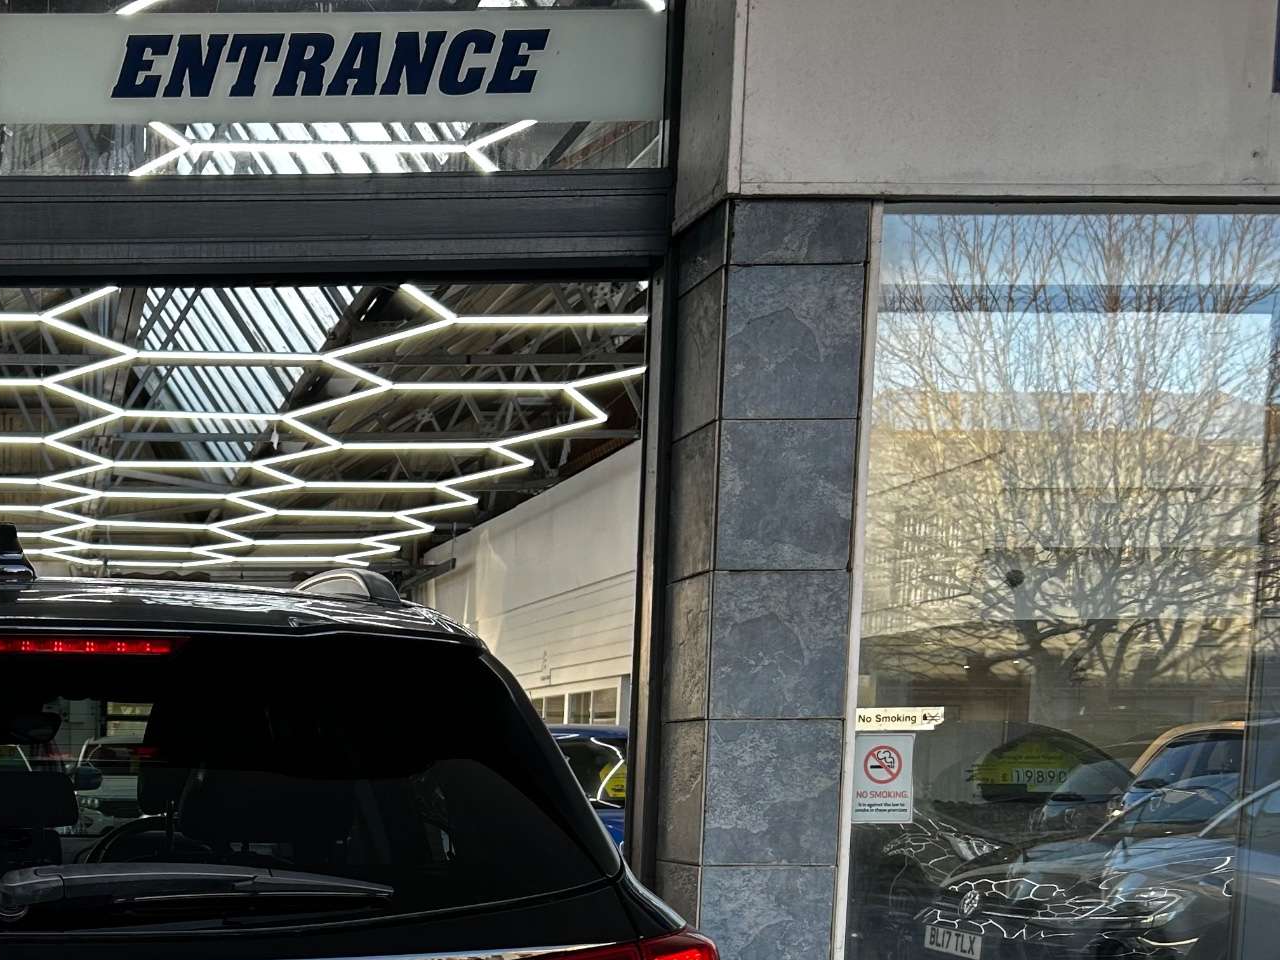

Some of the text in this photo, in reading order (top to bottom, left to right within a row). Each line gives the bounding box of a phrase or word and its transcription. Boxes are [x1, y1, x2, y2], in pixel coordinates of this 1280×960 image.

[111, 28, 551, 99] ENTRANCE
[858, 713, 917, 724] No Smoking
[856, 790, 909, 799] NO SMOKING
[929, 926, 976, 956] BL17 TLX
